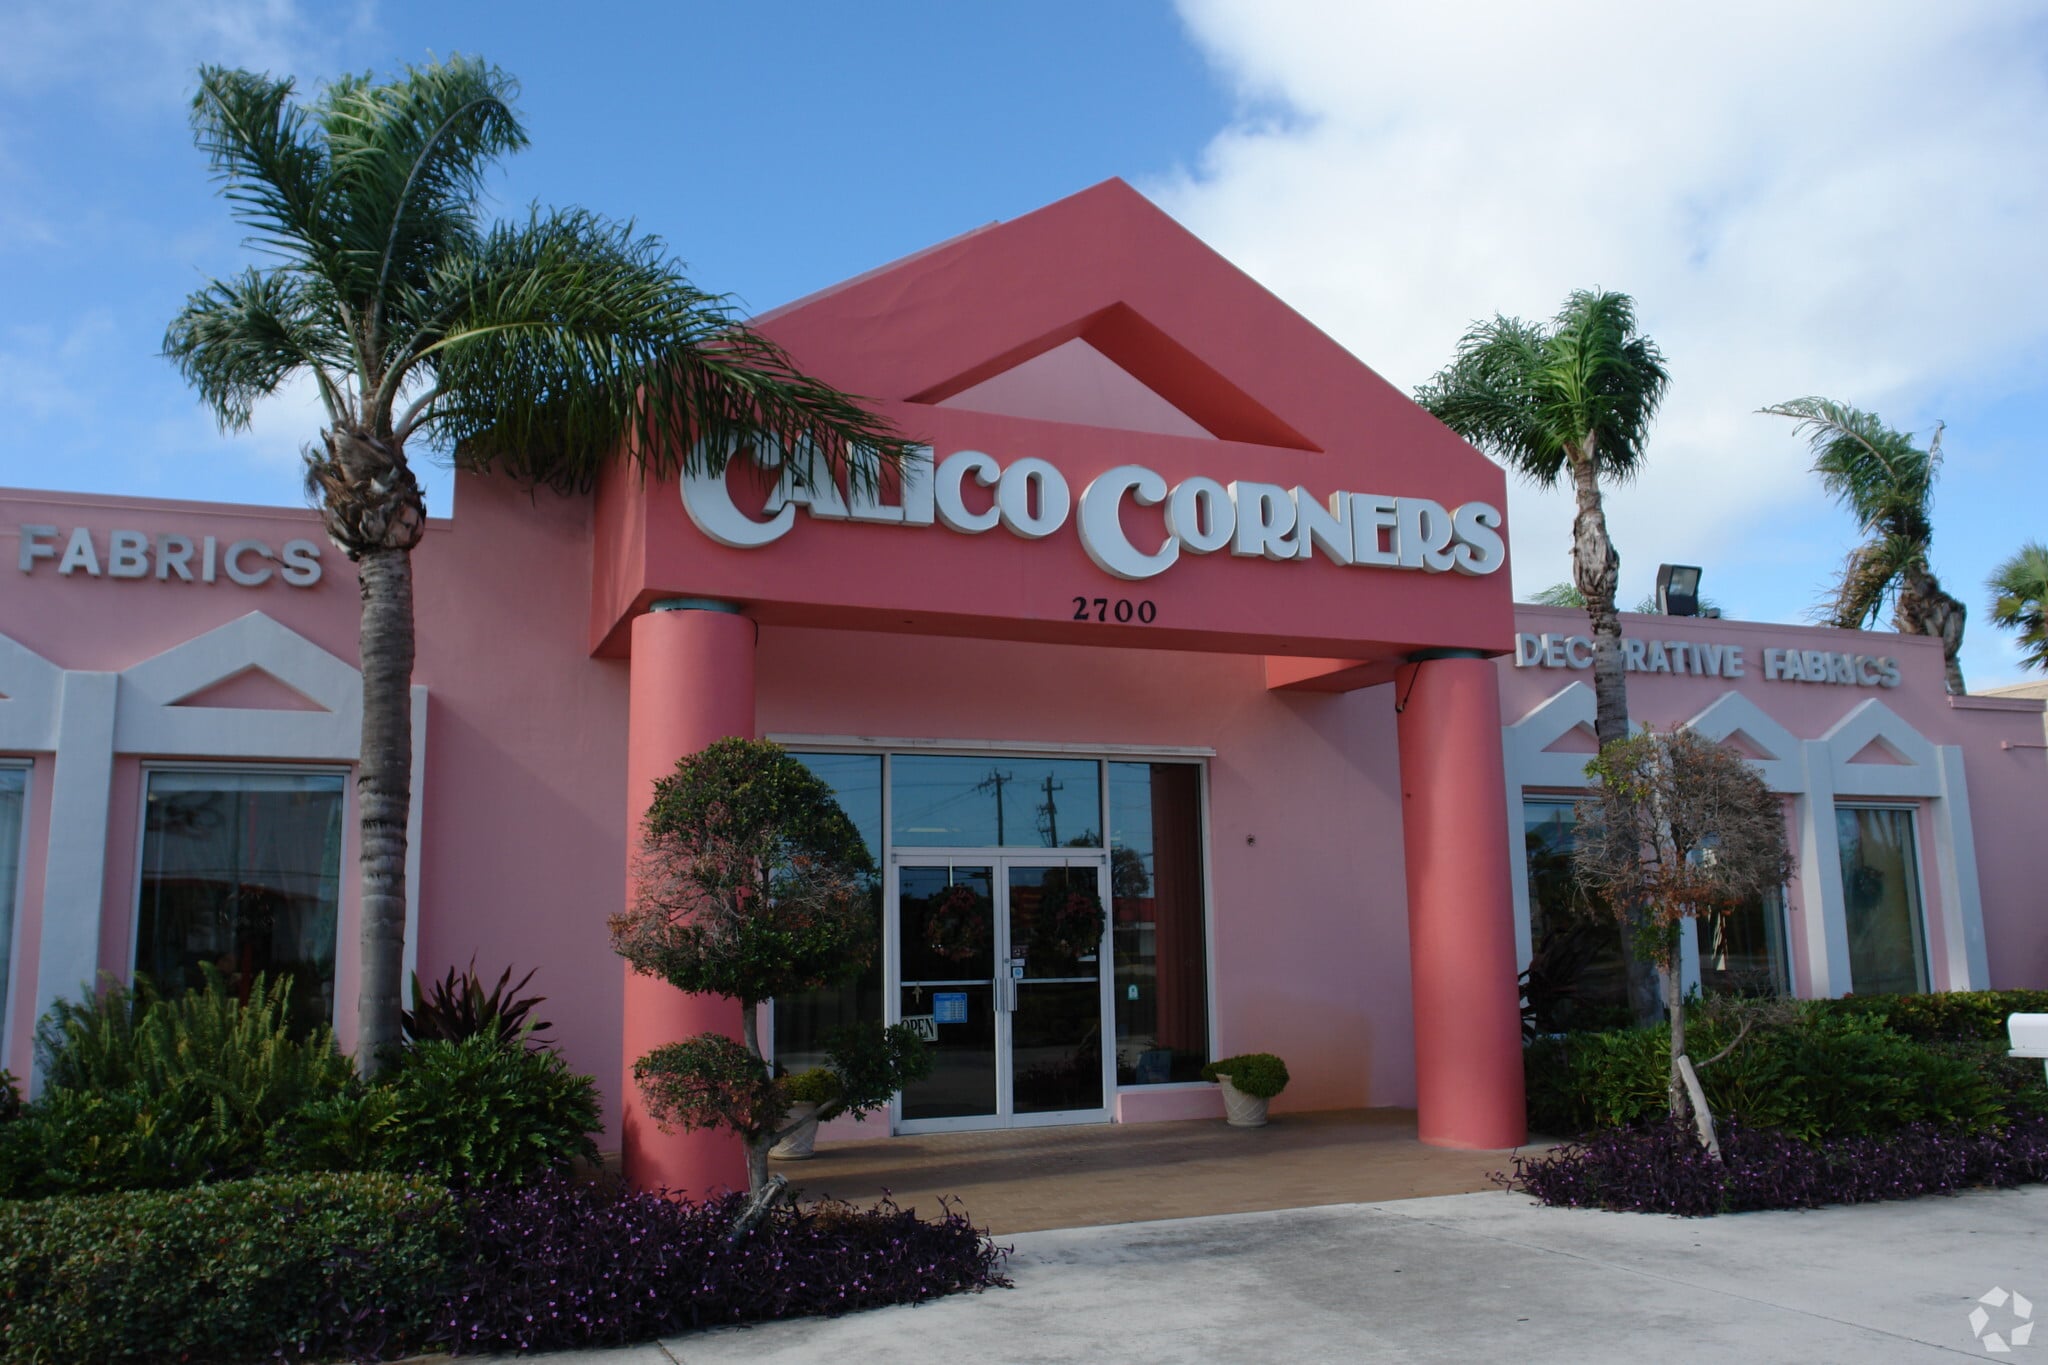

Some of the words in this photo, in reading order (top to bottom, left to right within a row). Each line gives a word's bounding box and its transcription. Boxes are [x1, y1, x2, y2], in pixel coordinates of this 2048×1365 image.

[680, 428, 1070, 548] CALICO
[1077, 464, 1506, 581] CORNERS
[18, 524, 322, 587] FABRICS
[1072, 596, 1157, 623] 2700
[1515, 632, 1744, 678] DECRATIVE
[1764, 647, 1901, 688] FABRICS
